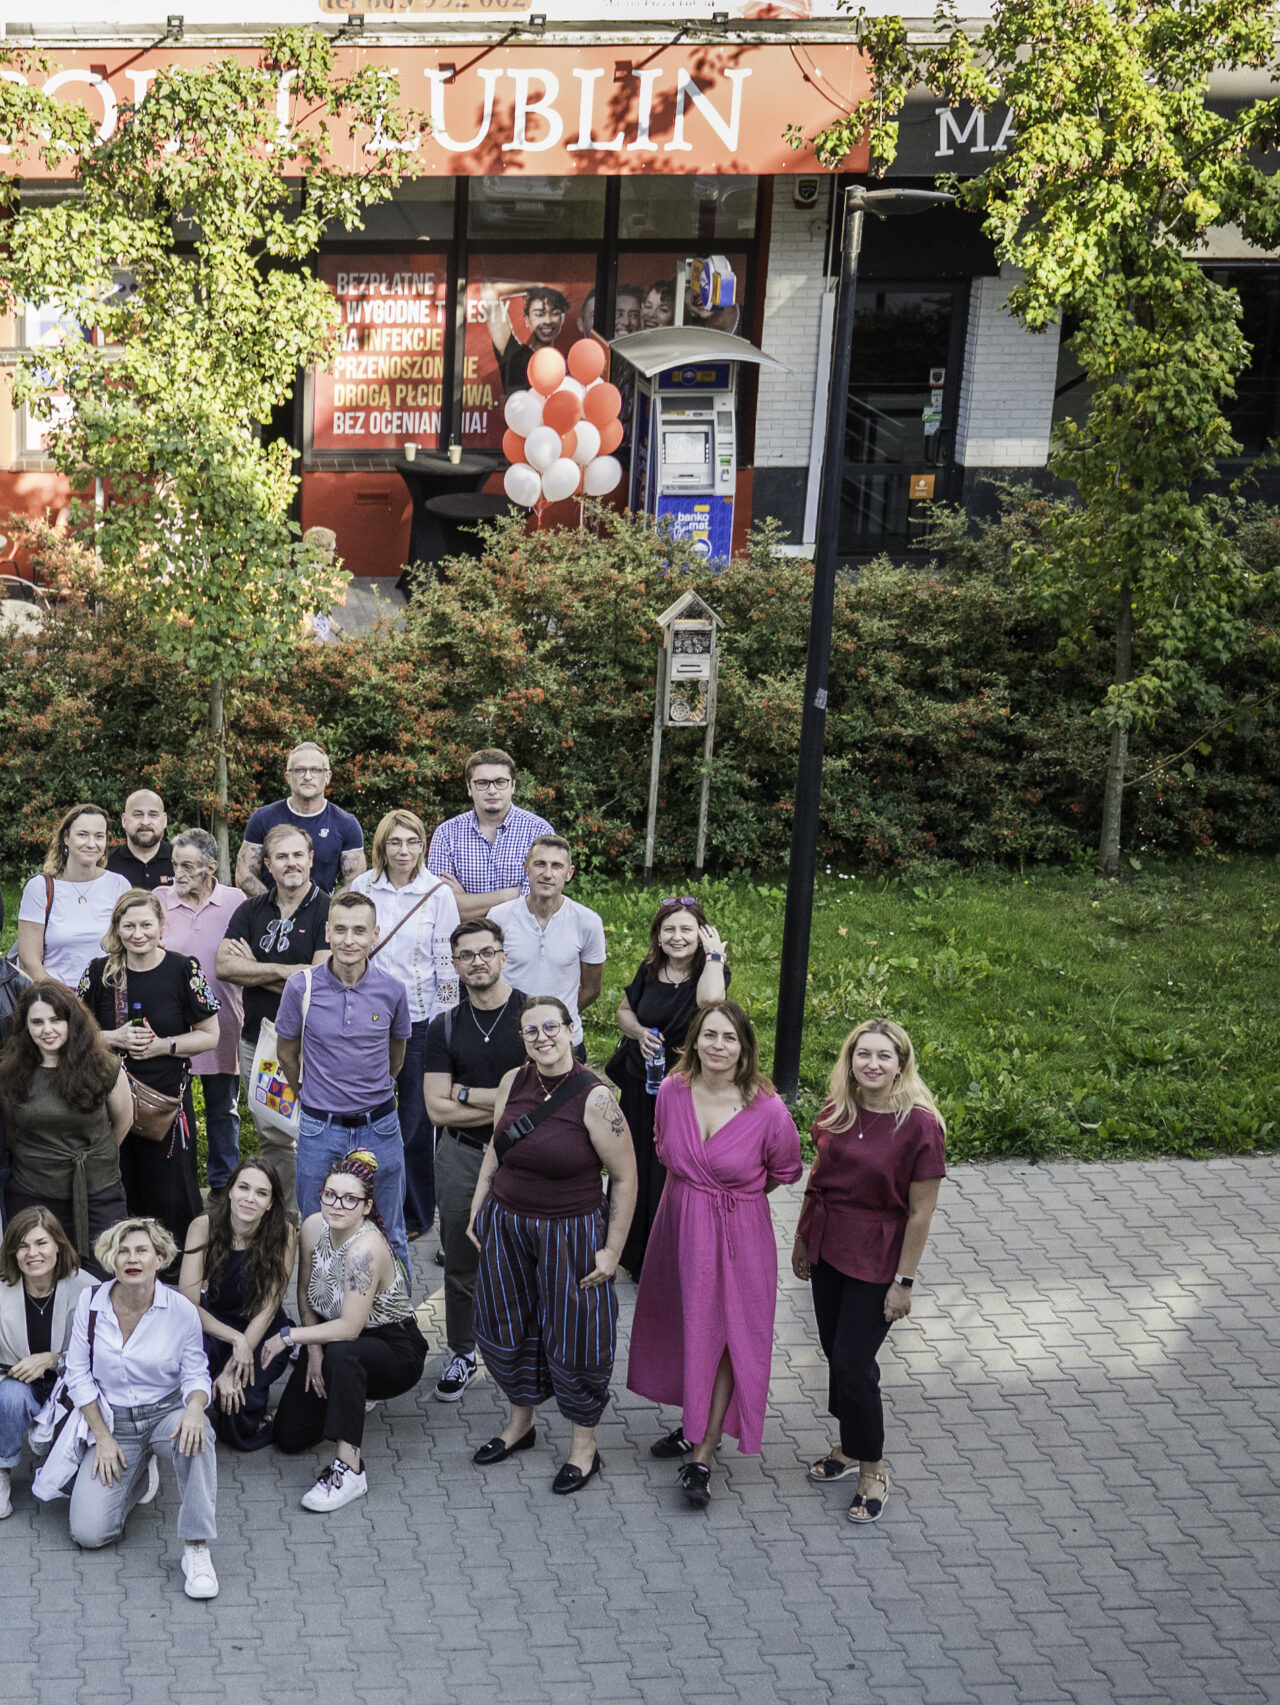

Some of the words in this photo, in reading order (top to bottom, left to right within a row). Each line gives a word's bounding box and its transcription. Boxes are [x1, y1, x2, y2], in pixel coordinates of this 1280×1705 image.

[336, 272, 435, 296] BEZPŁATNE
[346, 299, 431, 324] WYGODNE
[363, 327, 443, 352] INFEKCJE
[333, 383, 391, 411] DROGĄ
[333, 411, 365, 434] BEZ
[677, 511, 710, 522] banko
[688, 521, 710, 530] mat
